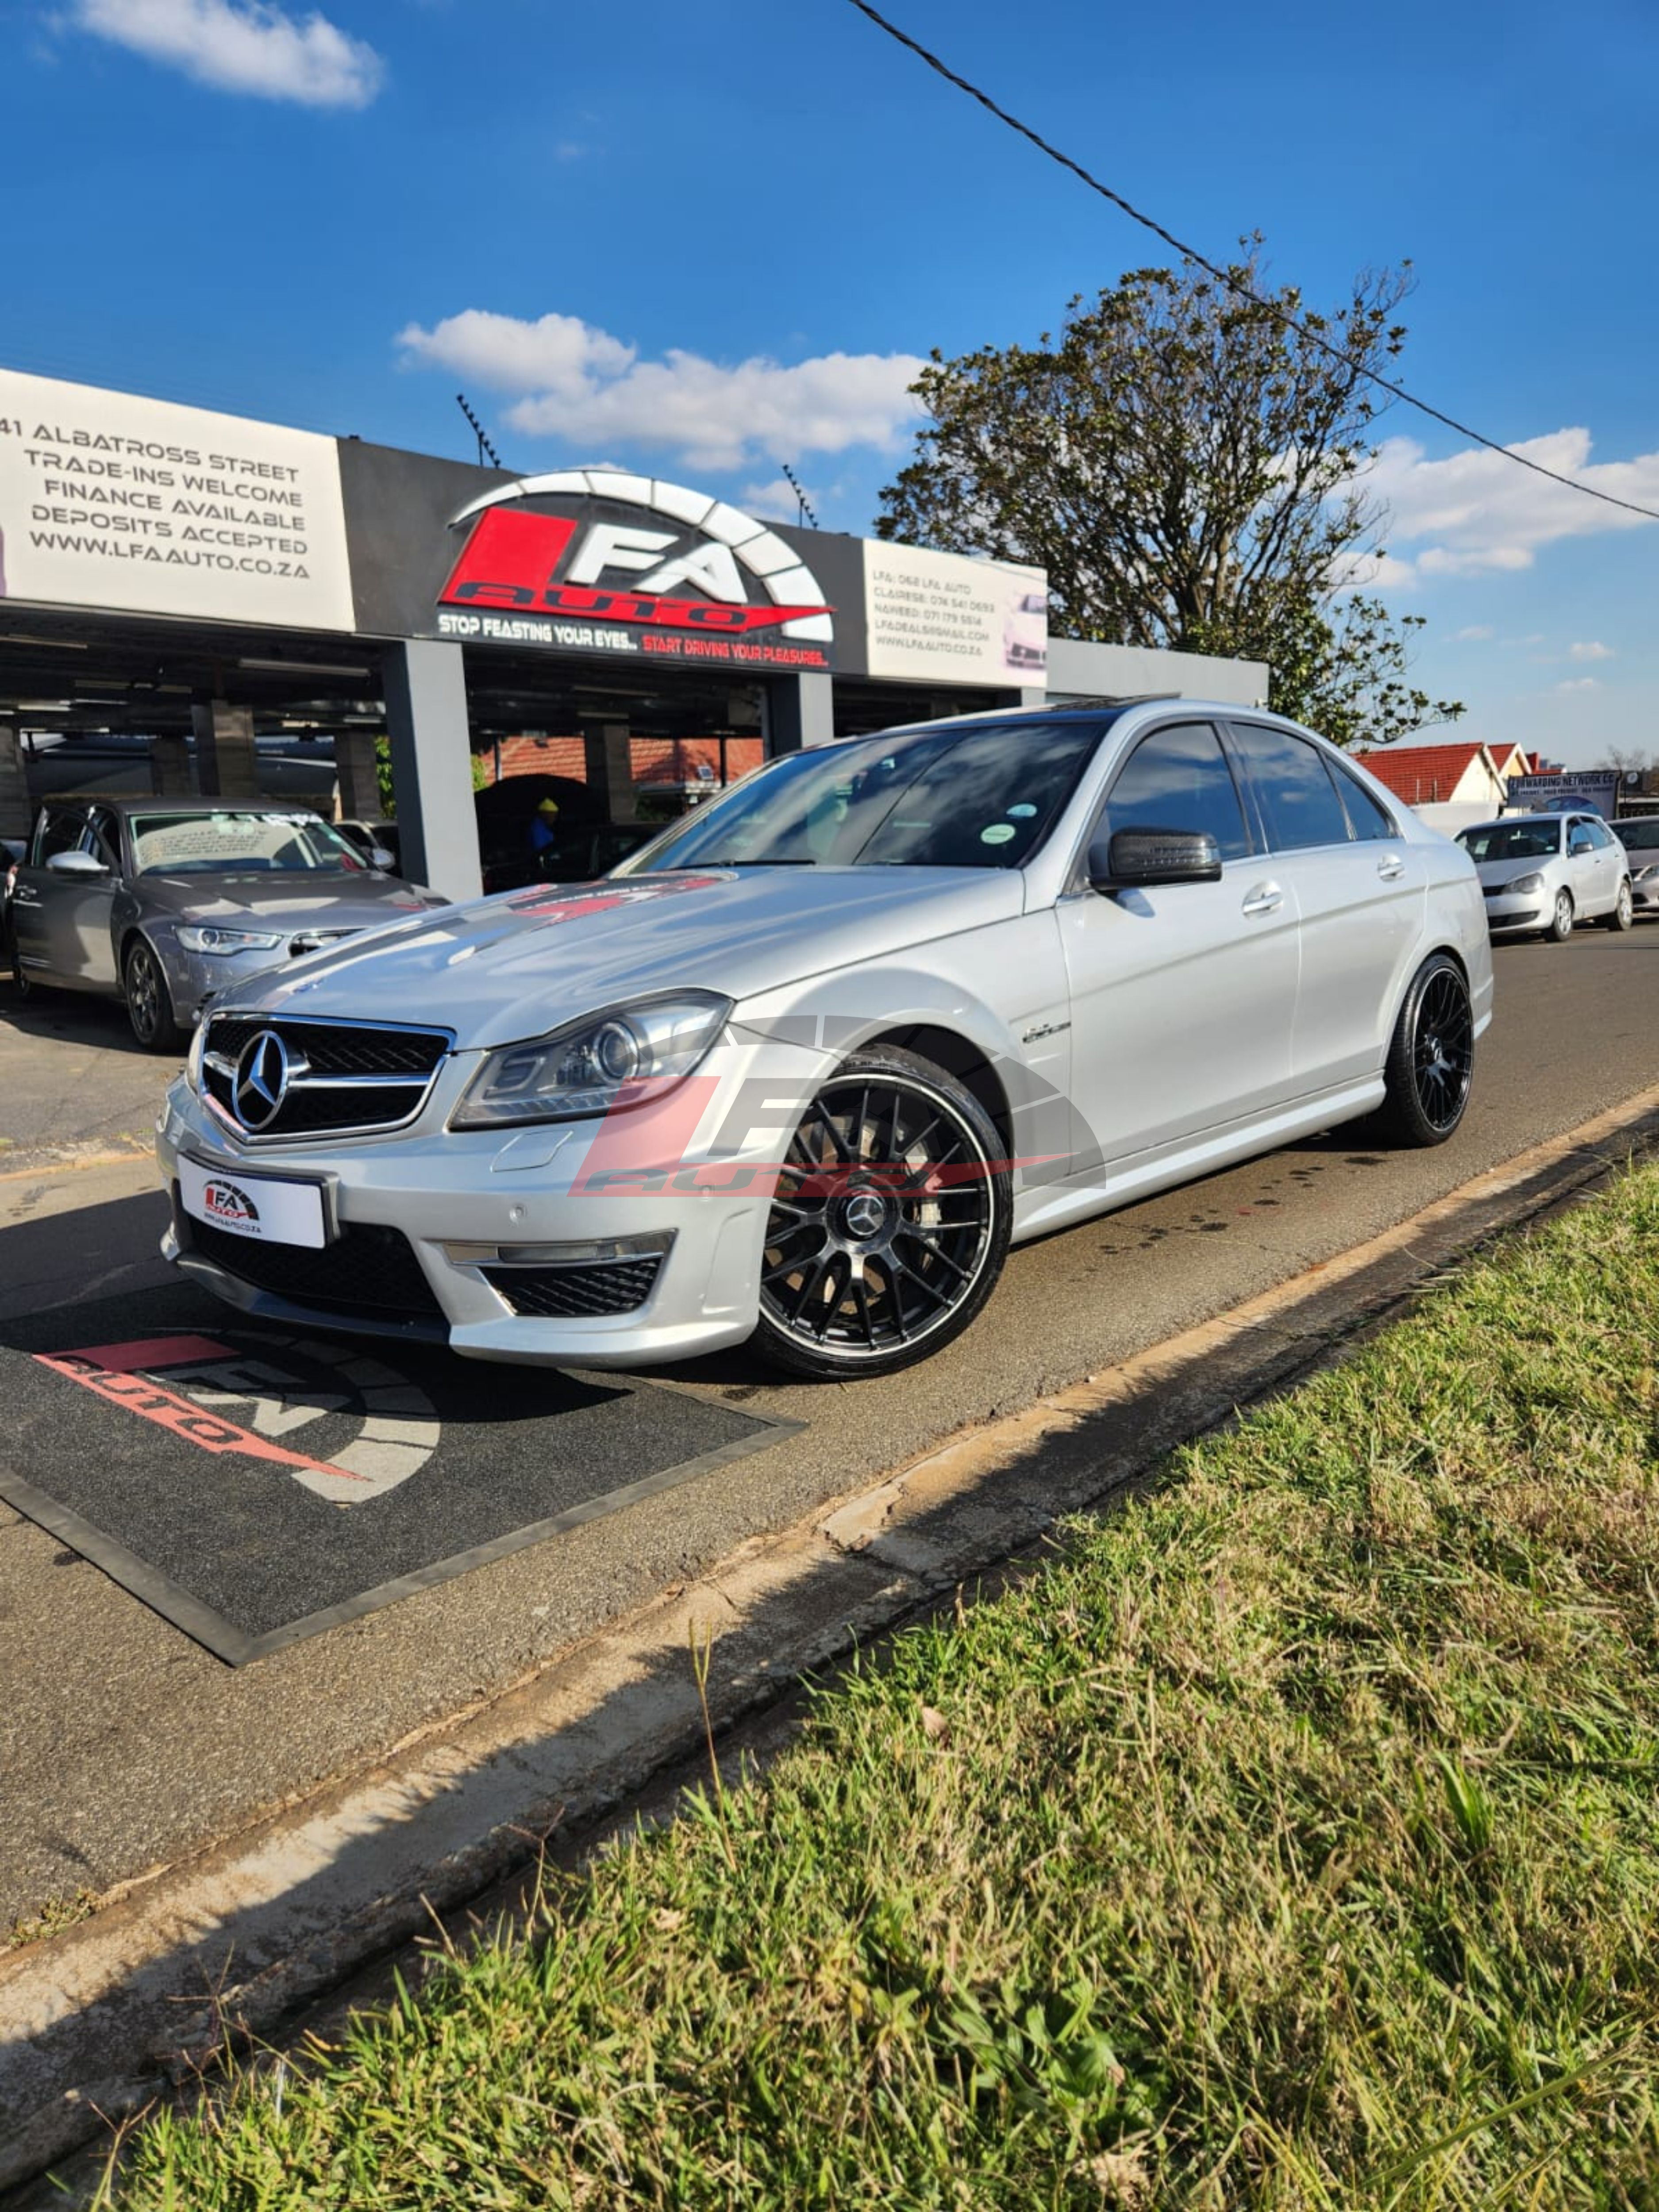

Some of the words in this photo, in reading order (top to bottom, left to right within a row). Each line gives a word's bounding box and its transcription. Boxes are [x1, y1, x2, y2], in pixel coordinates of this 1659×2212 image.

[0, 418, 22, 437] 41
[33, 423, 202, 466] ALBATROSS
[209, 454, 299, 483] STREET
[24, 449, 175, 487] TRADE-INS
[182, 474, 303, 507] WELCOME
[32, 504, 173, 538] DEPOSITS
[181, 525, 308, 554] ACCEPTED
[45, 478, 162, 511] FINANCE
[172, 499, 305, 531] AVAILABLE
[30, 531, 310, 579] WWW.LFAAUTO.CO.ZA
[455, 581, 748, 626] AUTO
[922, 577, 941, 590] LFA
[944, 581, 972, 595] AUTO
[439, 614, 481, 635] STOP
[482, 619, 552, 642] FEASTING
[554, 626, 594, 645] YOUR
[643, 635, 681, 653] START
[684, 639, 729, 658] DRIVING
[731, 643, 762, 660] YOUR
[1563, 773, 1600, 787] NETWORK
[53, 1355, 244, 1444] AUTO
